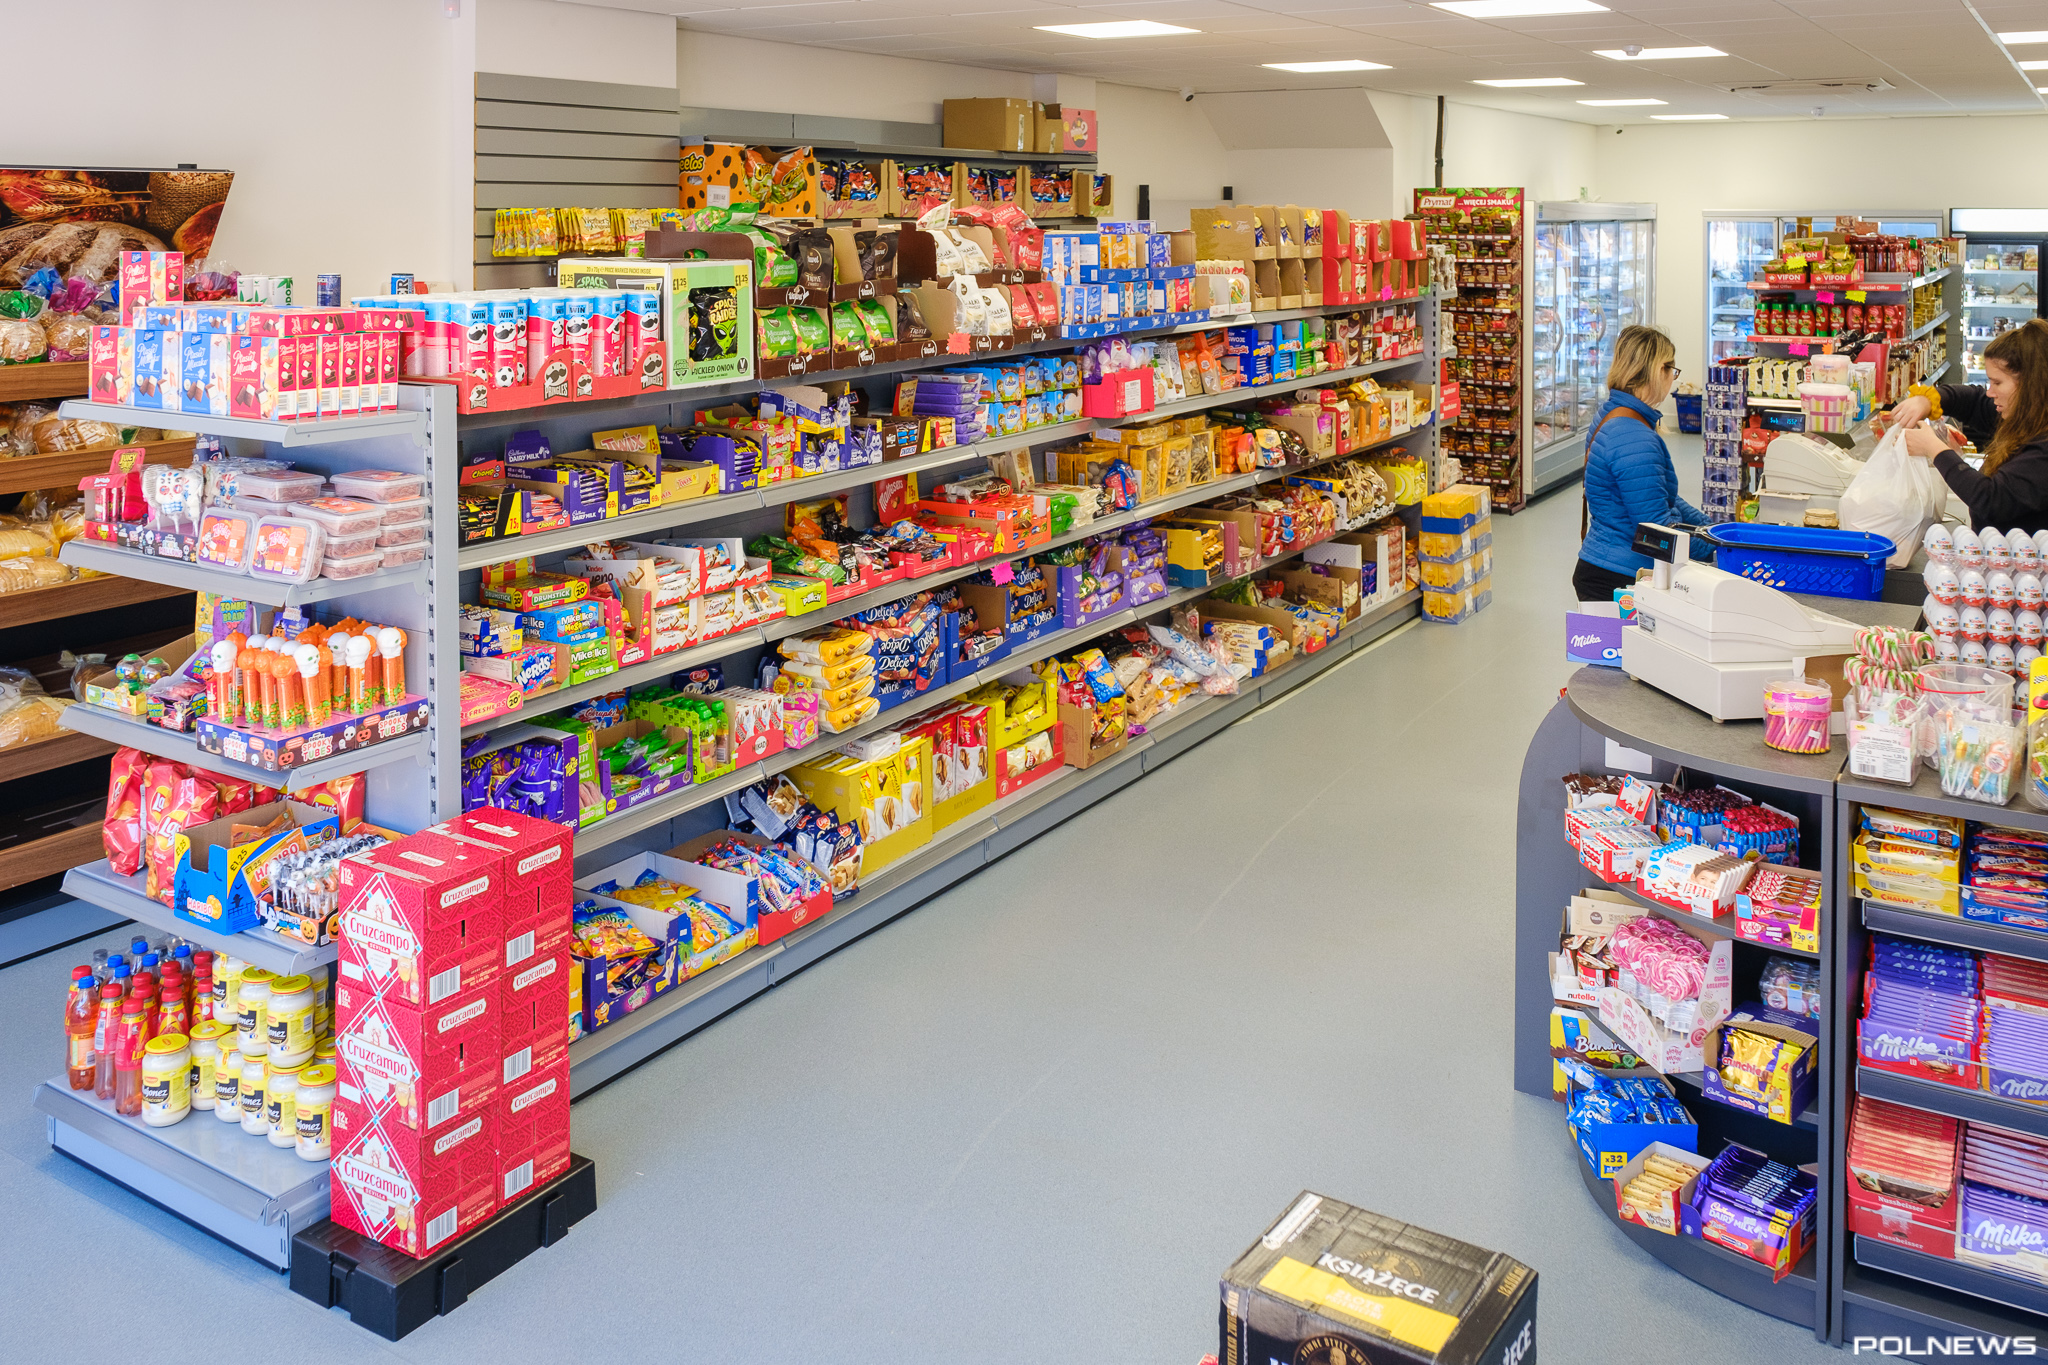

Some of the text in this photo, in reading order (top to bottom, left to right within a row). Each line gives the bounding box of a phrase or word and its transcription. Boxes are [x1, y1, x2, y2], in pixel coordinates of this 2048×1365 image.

[823, 198, 855, 219] Lorenz
[1424, 198, 1452, 207] Prymat
[561, 275, 573, 286] £1.25
[581, 276, 603, 286] SPACE
[673, 278, 687, 291] £1.25
[735, 274, 749, 286] £1.25
[716, 364, 734, 373] ONION
[544, 384, 568, 398] PRINGLES
[509, 454, 525, 462] DAIRY
[879, 479, 904, 513] Maltesers
[509, 518, 519, 530] 75p
[572, 514, 585, 522] DAIRY
[1017, 571, 1038, 586] Delicje
[485, 590, 511, 600] DRUMSTICK
[534, 590, 570, 603] DRUMSTICK
[1024, 593, 1043, 608] Delicje
[220, 601, 247, 612] ZOMBIE
[223, 611, 245, 622] BRAIN
[561, 607, 593, 624] Mike Ike
[867, 608, 895, 622] Delicje
[530, 618, 545, 628] Ike
[564, 624, 582, 632] Mega
[1571, 634, 1602, 647] Milka
[571, 647, 607, 662] Mike Ike
[622, 650, 644, 664] GIANTS
[879, 654, 910, 670] Delicje
[379, 714, 408, 730] SPOOKY
[380, 723, 407, 738] TUBES
[224, 738, 246, 752] SPOOKY
[302, 735, 333, 751] SPOOKY
[224, 749, 246, 762] TUBES
[304, 746, 332, 761] TUBES
[1893, 825, 1936, 839] CHALWA
[1883, 843, 1925, 856] CHALWA
[230, 849, 248, 872] £1.25
[520, 849, 559, 871] Cruzcampo
[443, 881, 486, 904] Cruzcampo
[1881, 893, 1914, 905] CHALWA
[187, 897, 213, 915] HARIBO
[350, 917, 410, 951] Cruzcampo
[1793, 931, 1806, 941] 75p
[369, 942, 389, 954] SEVILLA
[516, 962, 554, 987] Cruzcampo
[1568, 992, 1595, 1001] nutella
[441, 1003, 483, 1029] Cruzcampo
[1874, 1033, 1941, 1059] Milka
[347, 1039, 407, 1077] Cruzcampo
[365, 1066, 387, 1078] SEVILLA
[1723, 1057, 1762, 1077] crunchie
[514, 1082, 554, 1108] Cruzcampo
[1656, 1082, 1675, 1100] OREO
[1706, 1087, 1726, 1100] Cadbury
[1728, 1096, 1755, 1110] crunchie
[1650, 1102, 1665, 1124] OREO
[437, 1121, 479, 1150] Cruzcampo
[1605, 1155, 1622, 1163] x32
[344, 1161, 407, 1200] Cruzcampo
[364, 1188, 386, 1200] SEVILLA
[1710, 1202, 1735, 1218] Cadbury
[1878, 1195, 1925, 1213] Nussbeisser
[1709, 1210, 1734, 1225] DAIRY
[1877, 1232, 1924, 1250] Nussbeisser
[1974, 1220, 2044, 1252] Milka
[1317, 1252, 1439, 1304] KSIĄŻĘCE
